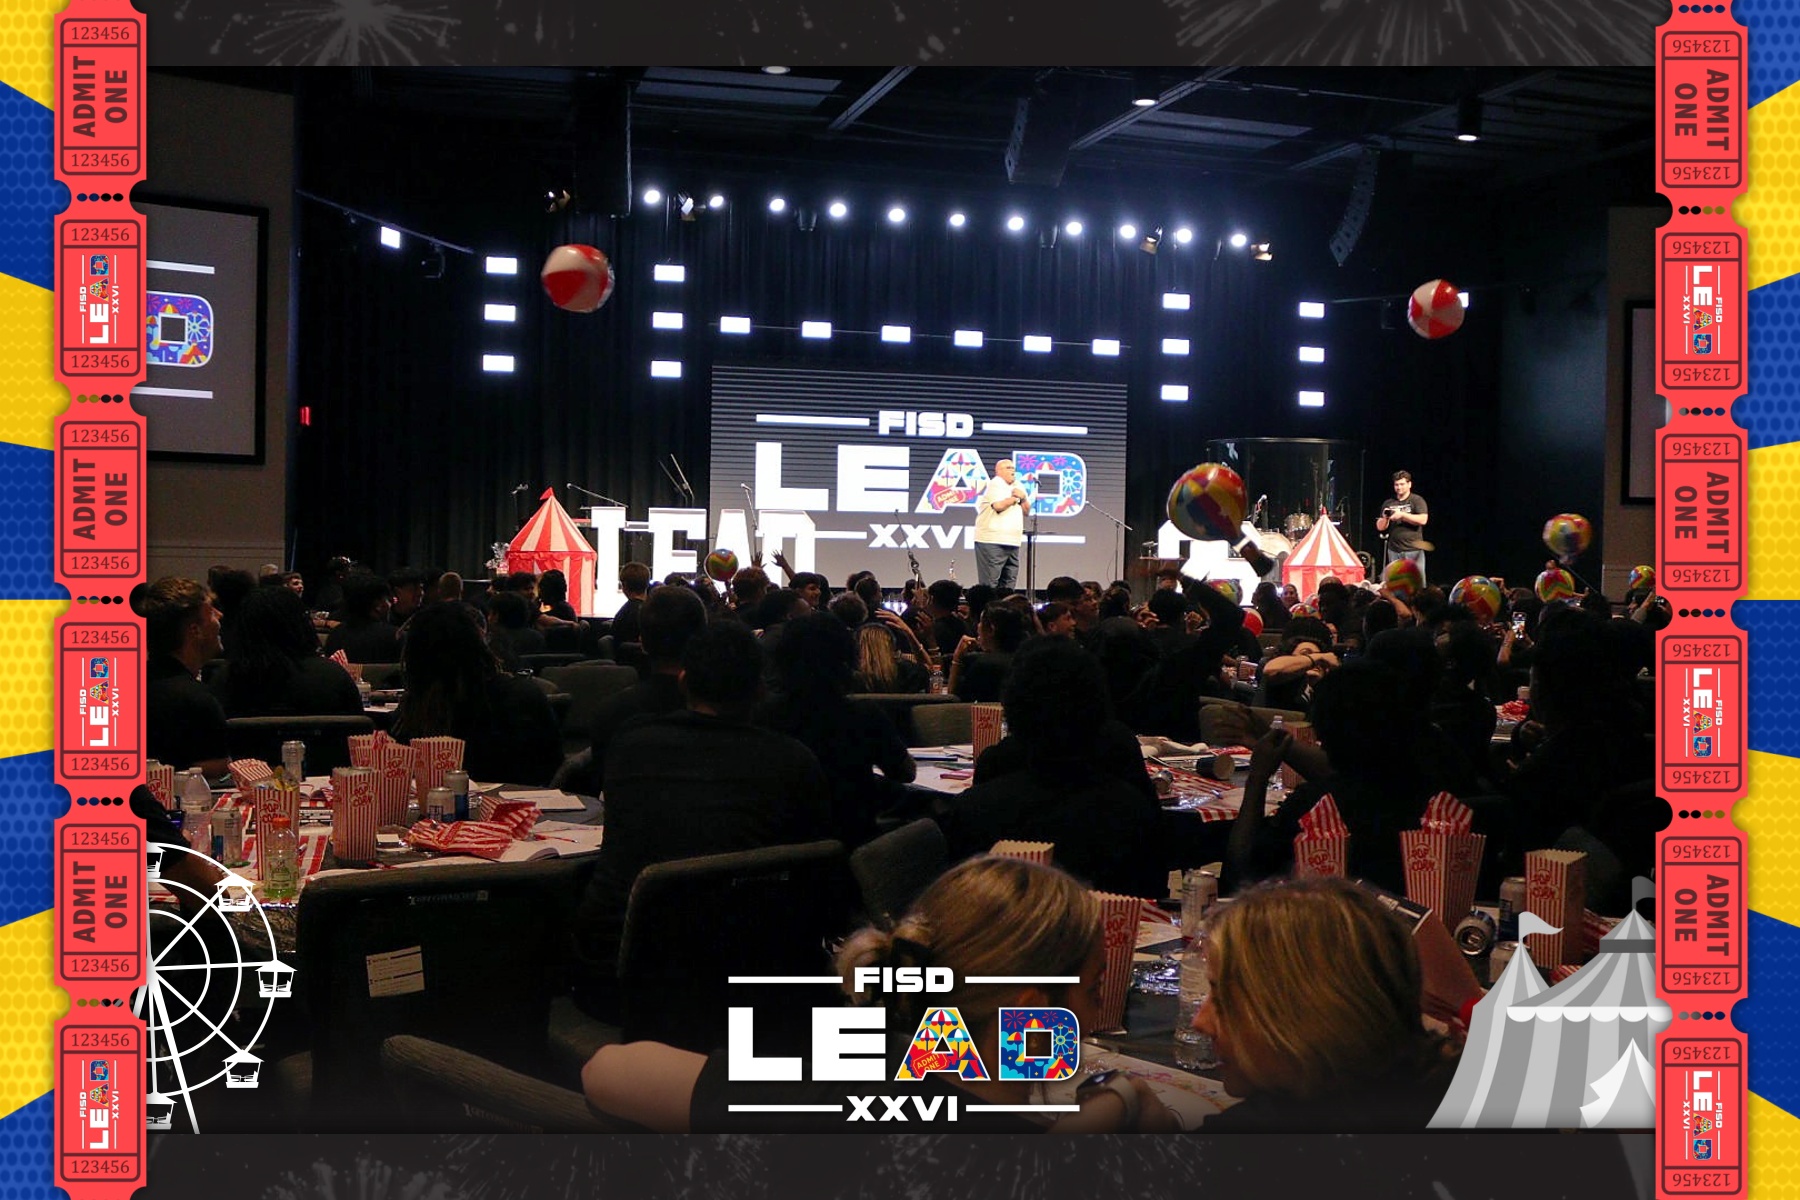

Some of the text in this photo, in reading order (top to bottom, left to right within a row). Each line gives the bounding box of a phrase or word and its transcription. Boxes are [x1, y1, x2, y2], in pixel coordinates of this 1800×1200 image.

[878, 410, 974, 438] FISD
[755, 441, 1087, 517] LEAD
[868, 523, 976, 550] XXVI
